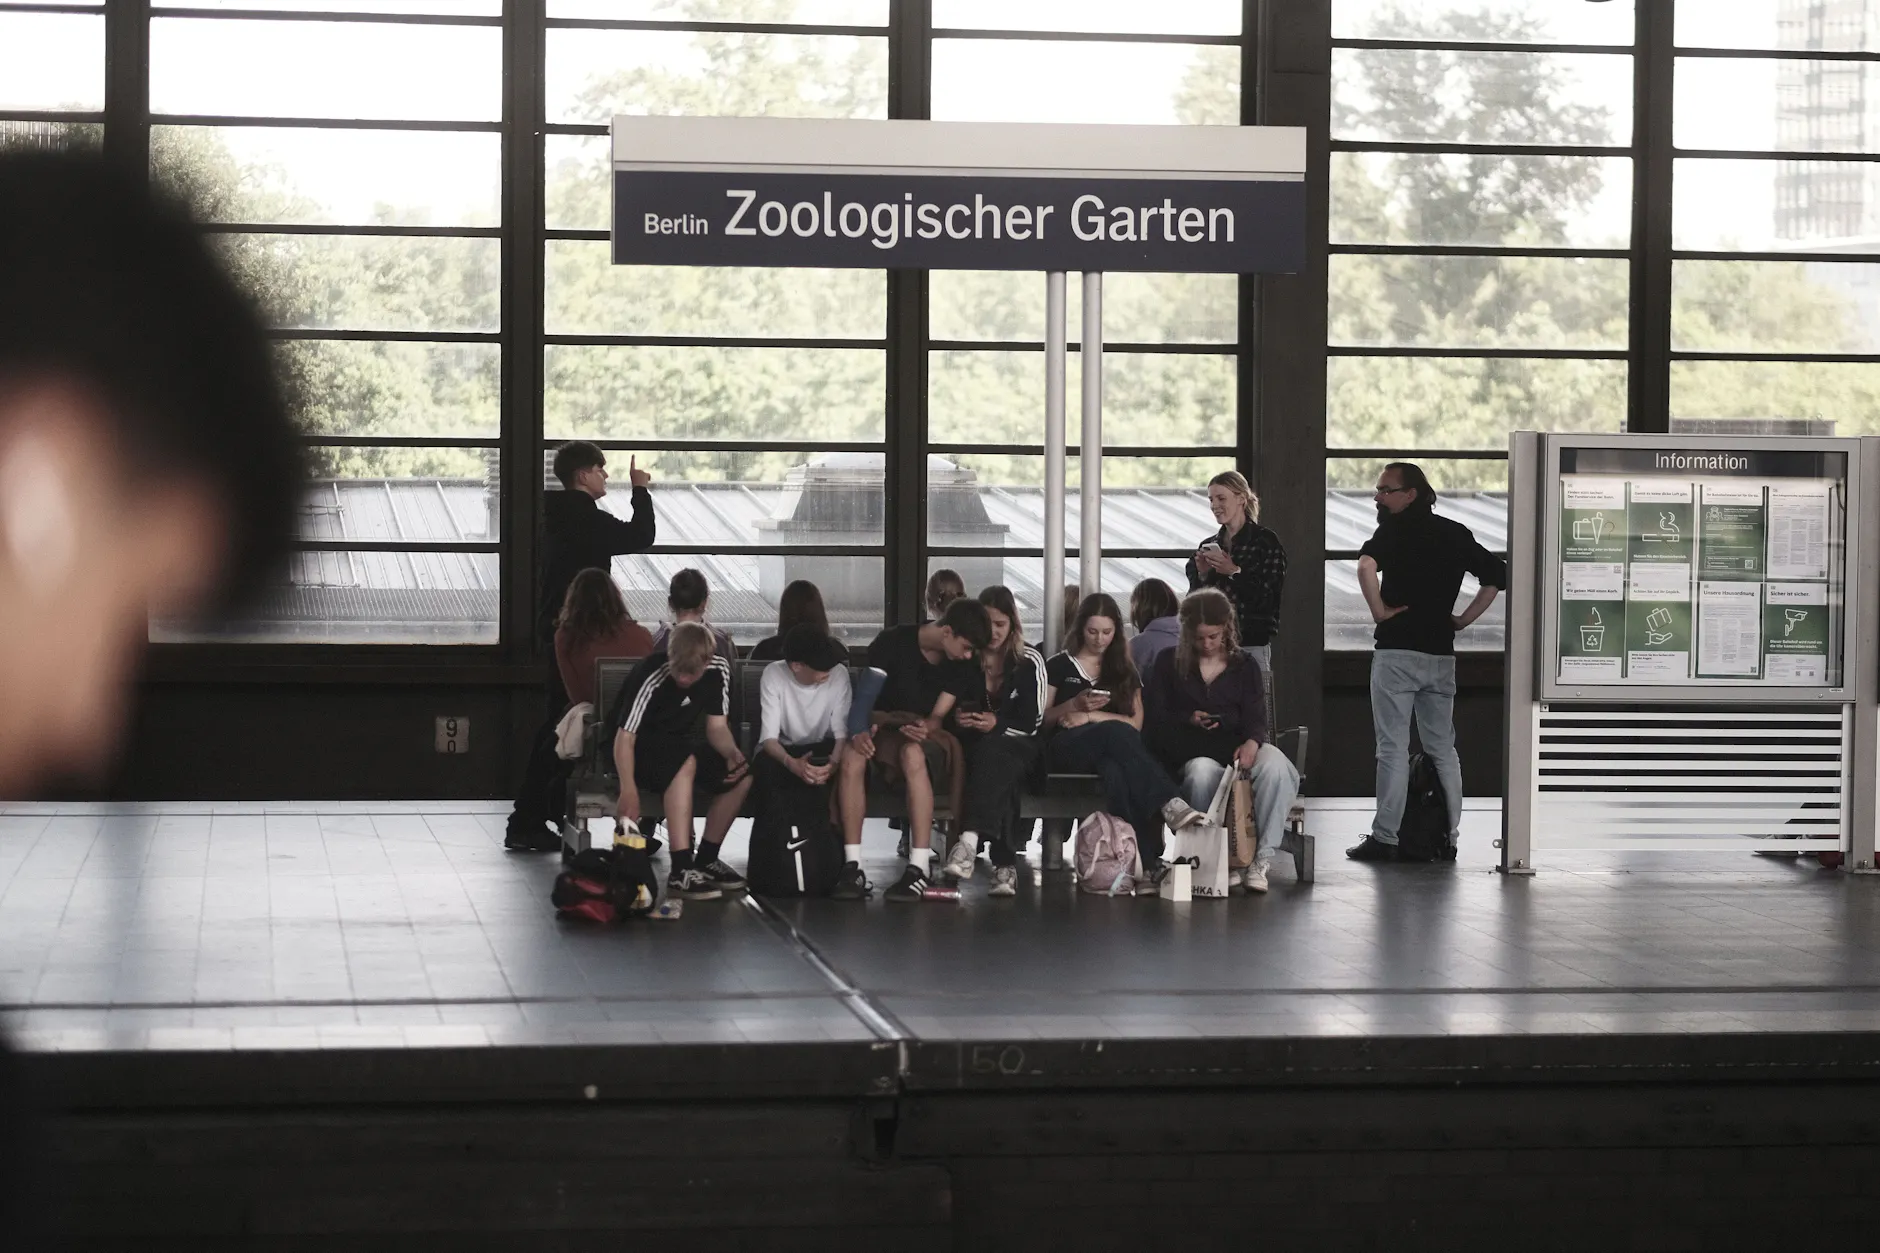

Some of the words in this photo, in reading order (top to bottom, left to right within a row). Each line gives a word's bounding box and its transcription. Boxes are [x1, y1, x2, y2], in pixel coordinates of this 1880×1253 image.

[644, 212, 709, 235] Berlin
[724, 189, 1055, 250] Zoologischer
[1070, 193, 1235, 243] Garten
[1655, 452, 1748, 470] Information
[446, 718, 458, 738] 9
[1191, 885, 1213, 896] HKA
